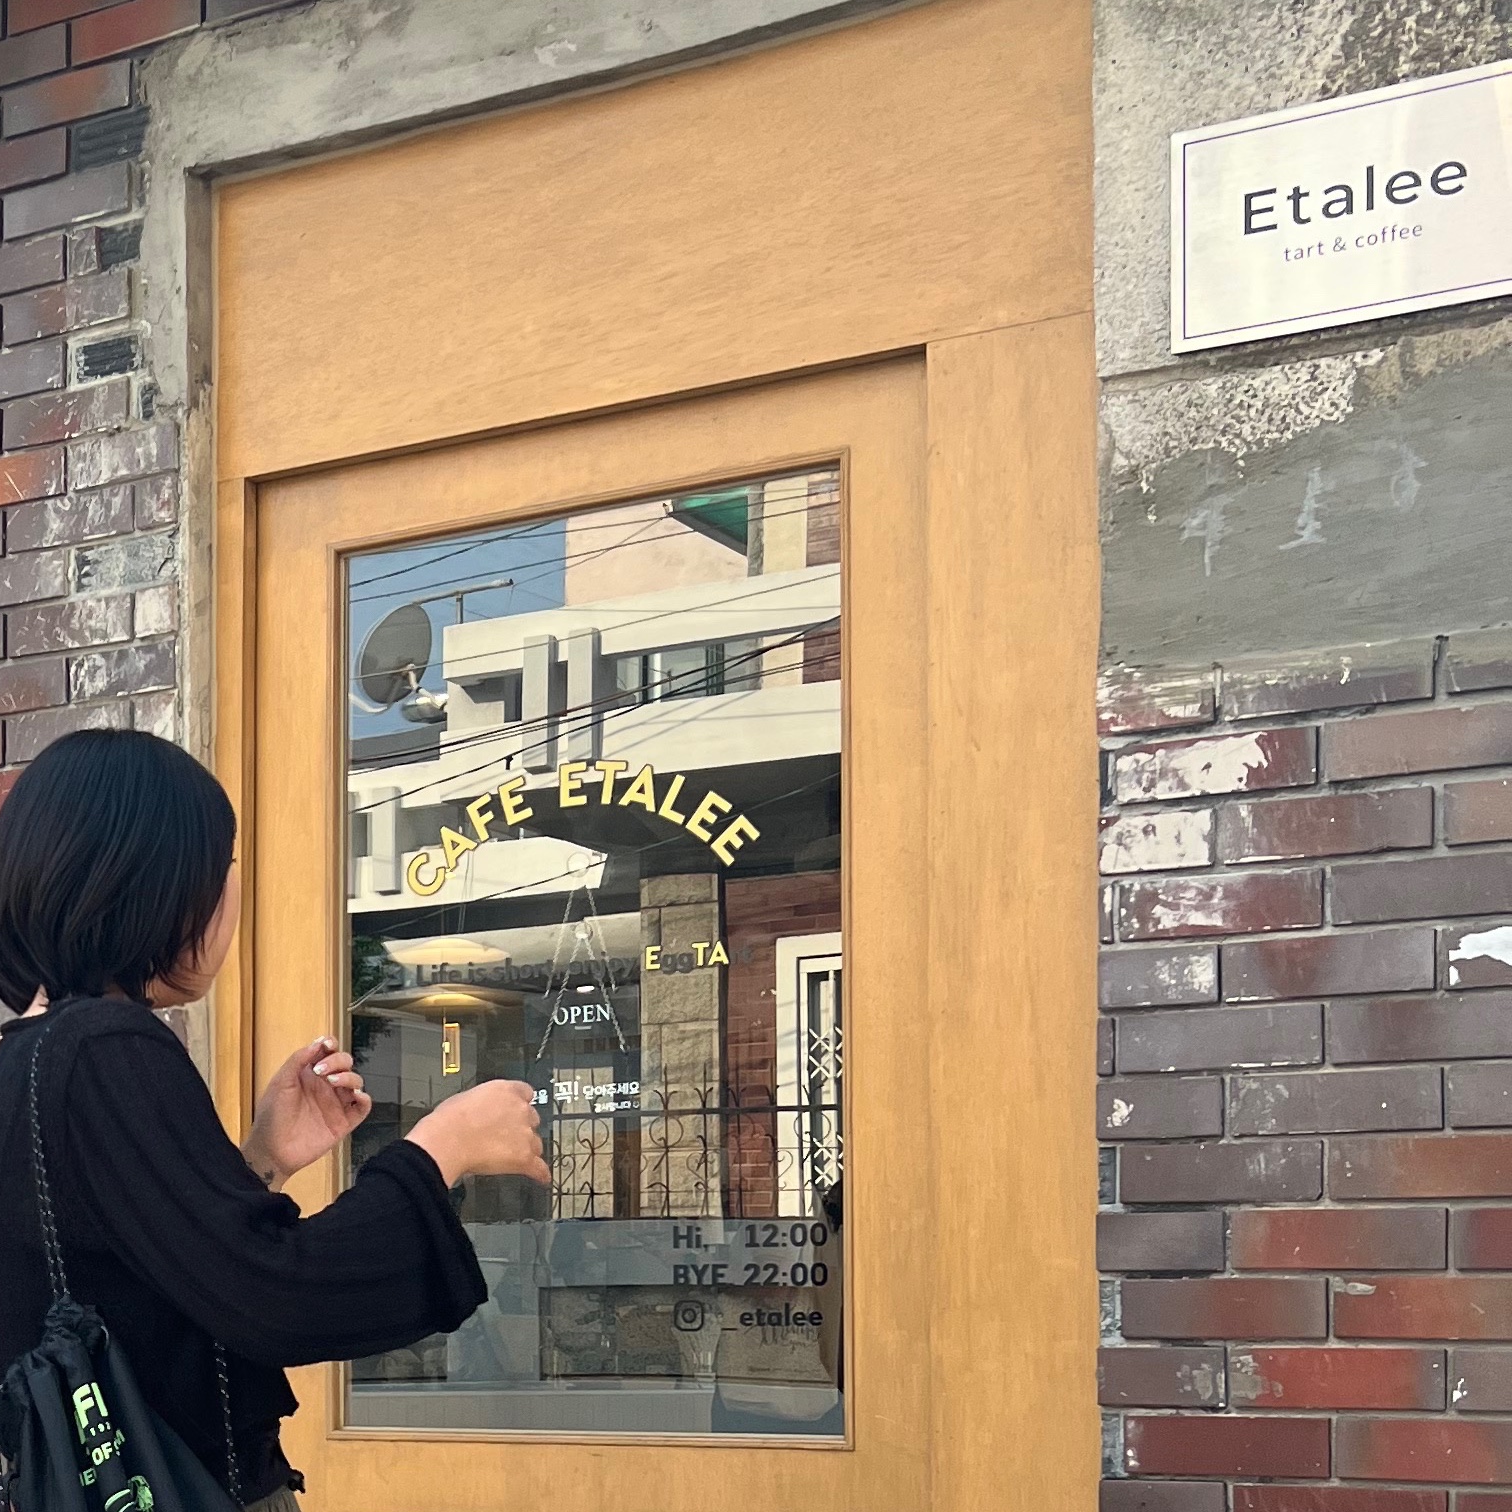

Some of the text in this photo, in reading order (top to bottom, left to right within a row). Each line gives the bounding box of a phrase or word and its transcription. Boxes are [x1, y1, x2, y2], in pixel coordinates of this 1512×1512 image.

[1243, 160, 1468, 236] Etalee
[1284, 223, 1424, 263] tart & coffee
[406, 759, 761, 896] CAFE ETALEE
[416, 962, 462, 985] Life
[468, 960, 487, 983] is
[553, 1003, 611, 1026] OPEN
[745, 1223, 828, 1248] 12:00
[743, 1262, 829, 1287] 22:00
